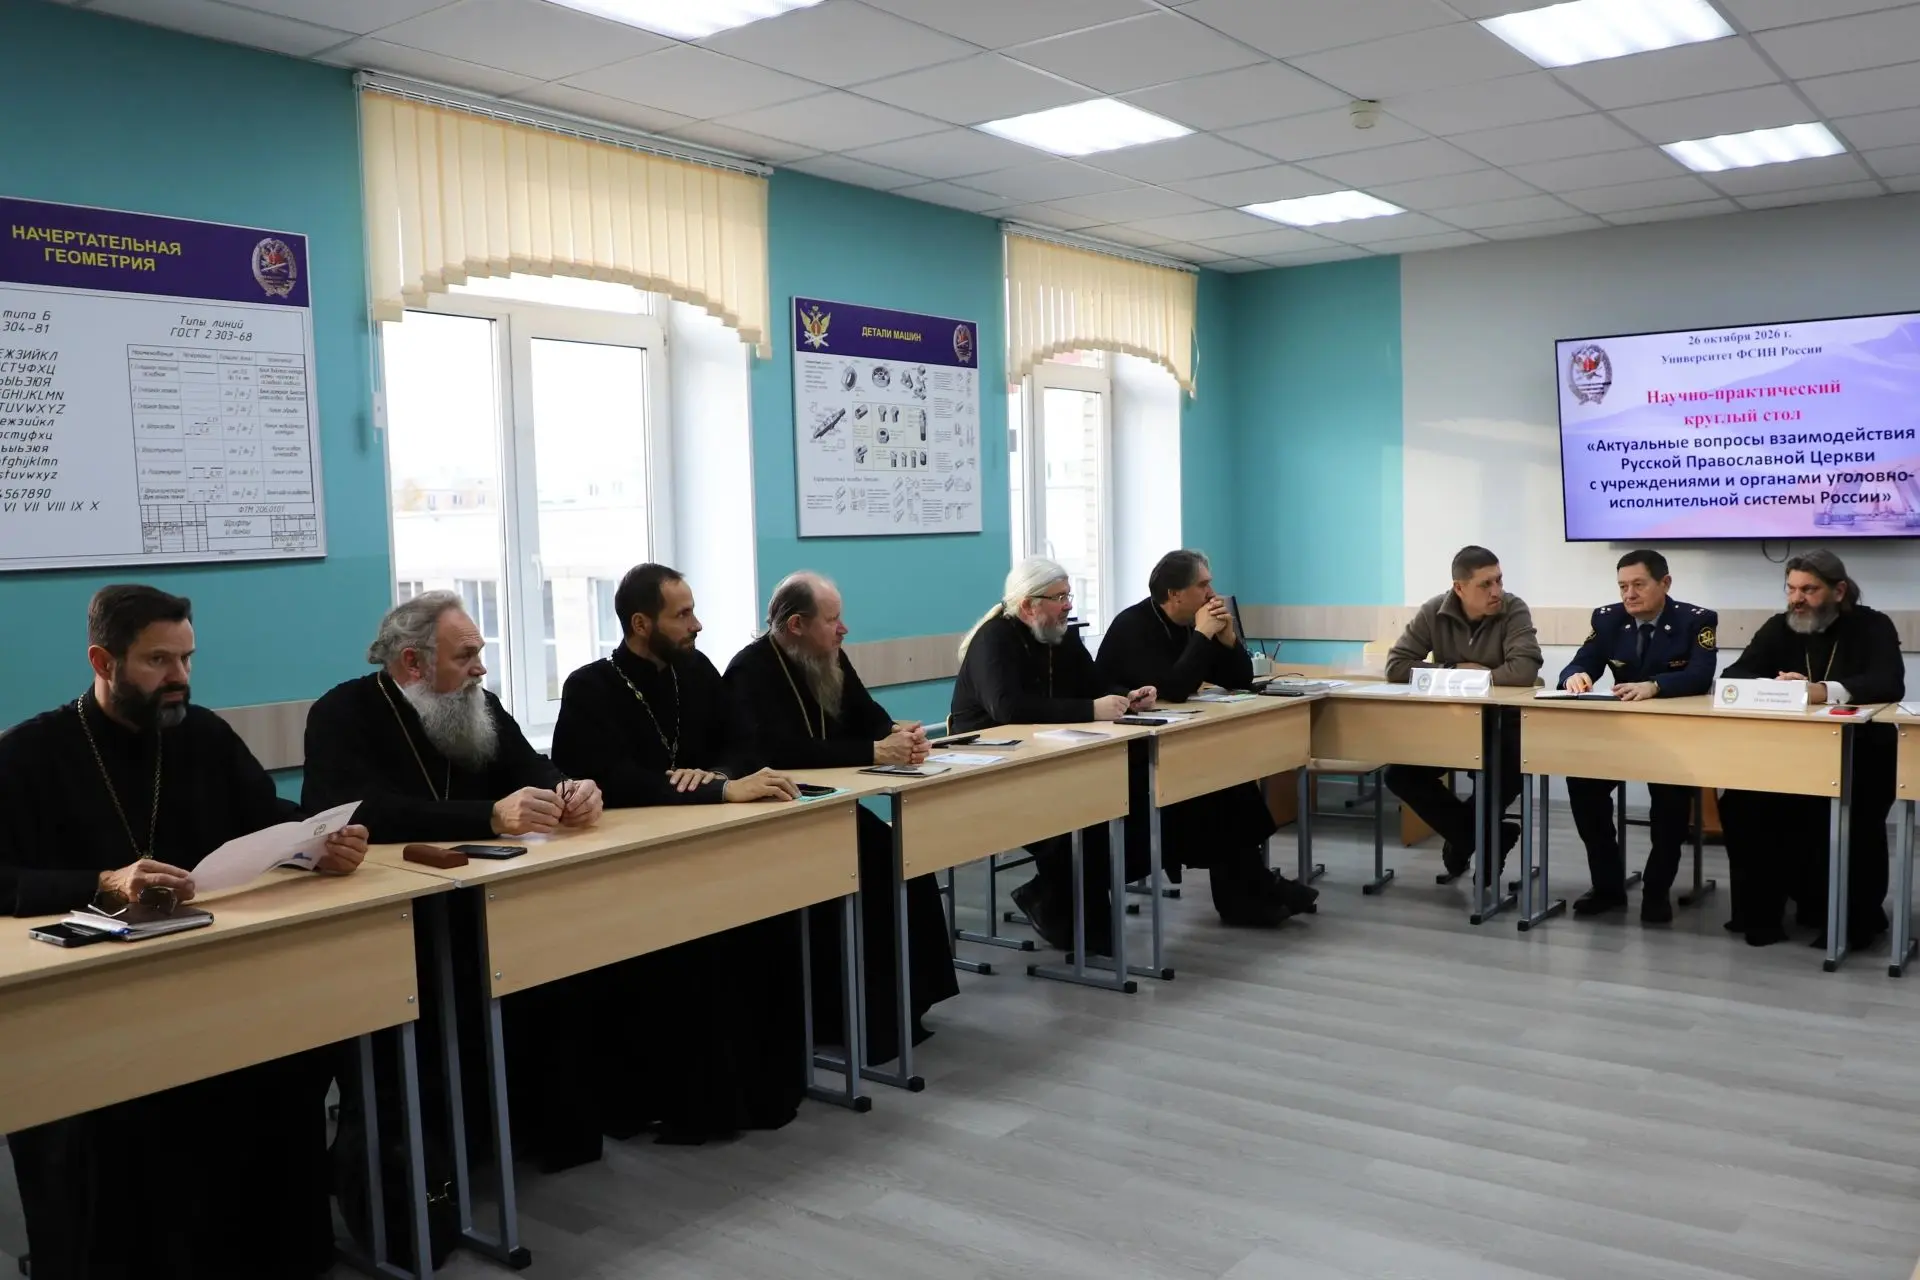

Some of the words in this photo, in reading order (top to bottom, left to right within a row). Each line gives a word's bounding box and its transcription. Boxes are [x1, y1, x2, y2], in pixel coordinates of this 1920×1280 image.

[12, 224, 182, 256] НАЧЕРТАТЕЛЬНАЯ
[44, 247, 156, 271] ГЕОМЕТРИЯ
[2, 310, 37, 320] типа
[42, 310, 51, 320] Б
[180, 315, 206, 326] Типы
[212, 319, 244, 329] линий
[2, 321, 49, 333] 304-81
[170, 327, 200, 338] ГОСТ
[862, 326, 891, 338] ДЕТАЛИ
[893, 330, 921, 342] МАШИН
[1688, 336, 1700, 345] 26
[1703, 333, 1750, 344] октября
[1755, 329, 1780, 340] 2026
[1783, 330, 1791, 338] г.
[1661, 353, 1733, 364] Университет
[1736, 347, 1777, 358] ФСИН
[1781, 345, 1822, 357] России
[0, 362, 56, 375] СТУФХЦ
[1646, 380, 1841, 406] Научно-практический
[1684, 409, 1757, 428] круглый
[1763, 409, 1801, 422] стол
[1587, 438, 1689, 453] «Актуальные
[1694, 435, 1764, 449] вопросы
[1770, 427, 1915, 445] взаимодействия
[0, 456, 58, 468] fghijklmn
[1621, 456, 1681, 472] Русской
[1686, 451, 1805, 471] Православной
[1810, 450, 1875, 466] Церкви
[1590, 480, 1597, 490] с
[1600, 476, 1720, 492] учреждениями
[1726, 476, 1735, 486] и
[1740, 473, 1821, 488] органами
[1826, 470, 1915, 486] уголовно-
[70, 501, 85, 511] IX
[1610, 493, 1739, 508] исполнительной
[1744, 494, 1815, 505] системы
[1820, 491, 1891, 504] России»
